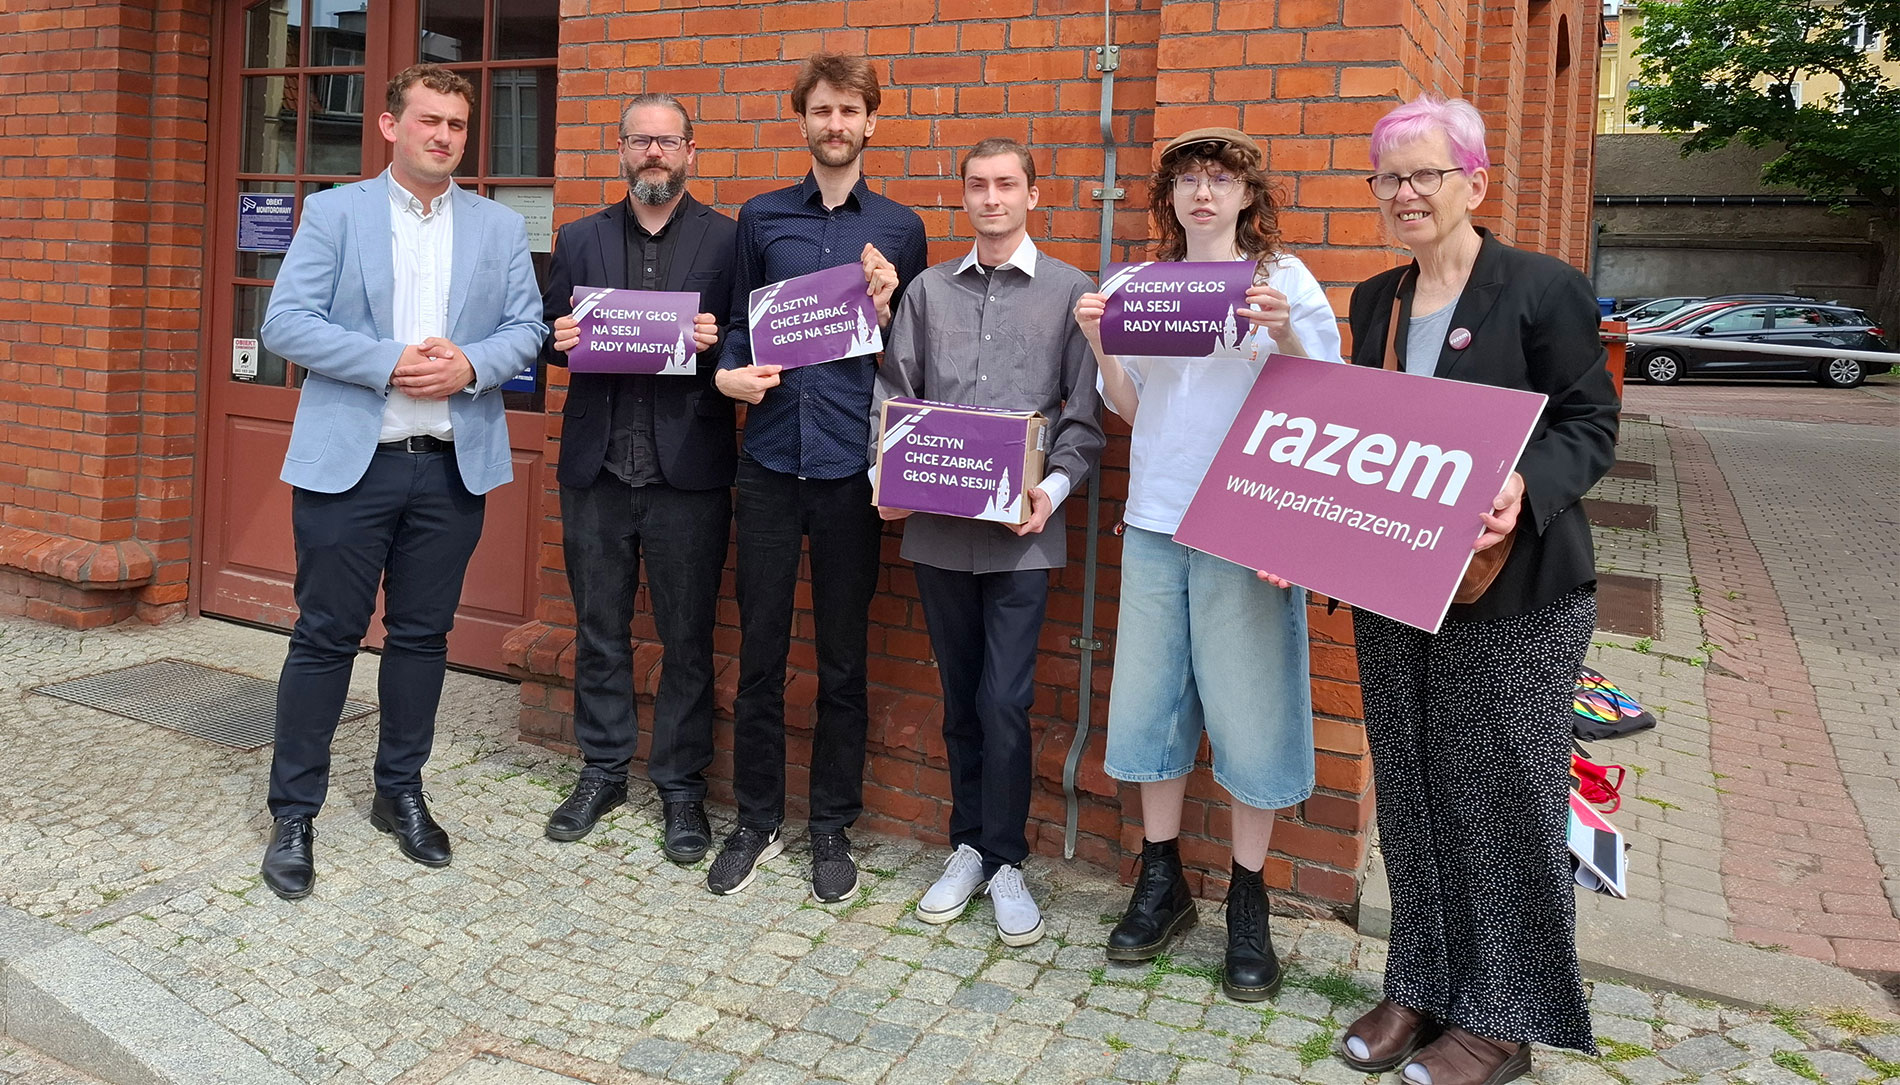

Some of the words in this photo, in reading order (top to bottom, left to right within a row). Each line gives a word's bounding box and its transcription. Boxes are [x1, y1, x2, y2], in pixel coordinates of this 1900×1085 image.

[1125, 281, 1185, 293] CHCEMY
[1187, 281, 1226, 293] GŁOS
[769, 294, 819, 315] OLSZTYN
[1123, 300, 1144, 312] NA
[1146, 300, 1180, 312] SESJI
[592, 308, 644, 320] CHCEMY
[645, 310, 678, 322] GŁOS
[770, 314, 801, 330] CHCE
[802, 301, 849, 323] ZABRAĆ
[592, 324, 609, 335] NA
[611, 325, 640, 336] SESJI
[772, 330, 803, 346] GŁOS
[804, 327, 823, 339] NA
[823, 319, 856, 335] SESJI!
[1123, 320, 1162, 332] RADY
[1165, 320, 1223, 333] MIASTA!
[590, 340, 624, 353] RADY
[625, 342, 674, 354] MIASTA!
[906, 433, 964, 450] OLSZTYN
[904, 451, 940, 466] CHCE
[940, 455, 994, 472] ZABRAĆ
[1242, 409, 1473, 507] razem
[903, 469, 937, 484] GŁOS
[939, 473, 959, 487] NA
[960, 476, 996, 491] SESJI!
[1226, 474, 1444, 551] www.partiarazem.pl
